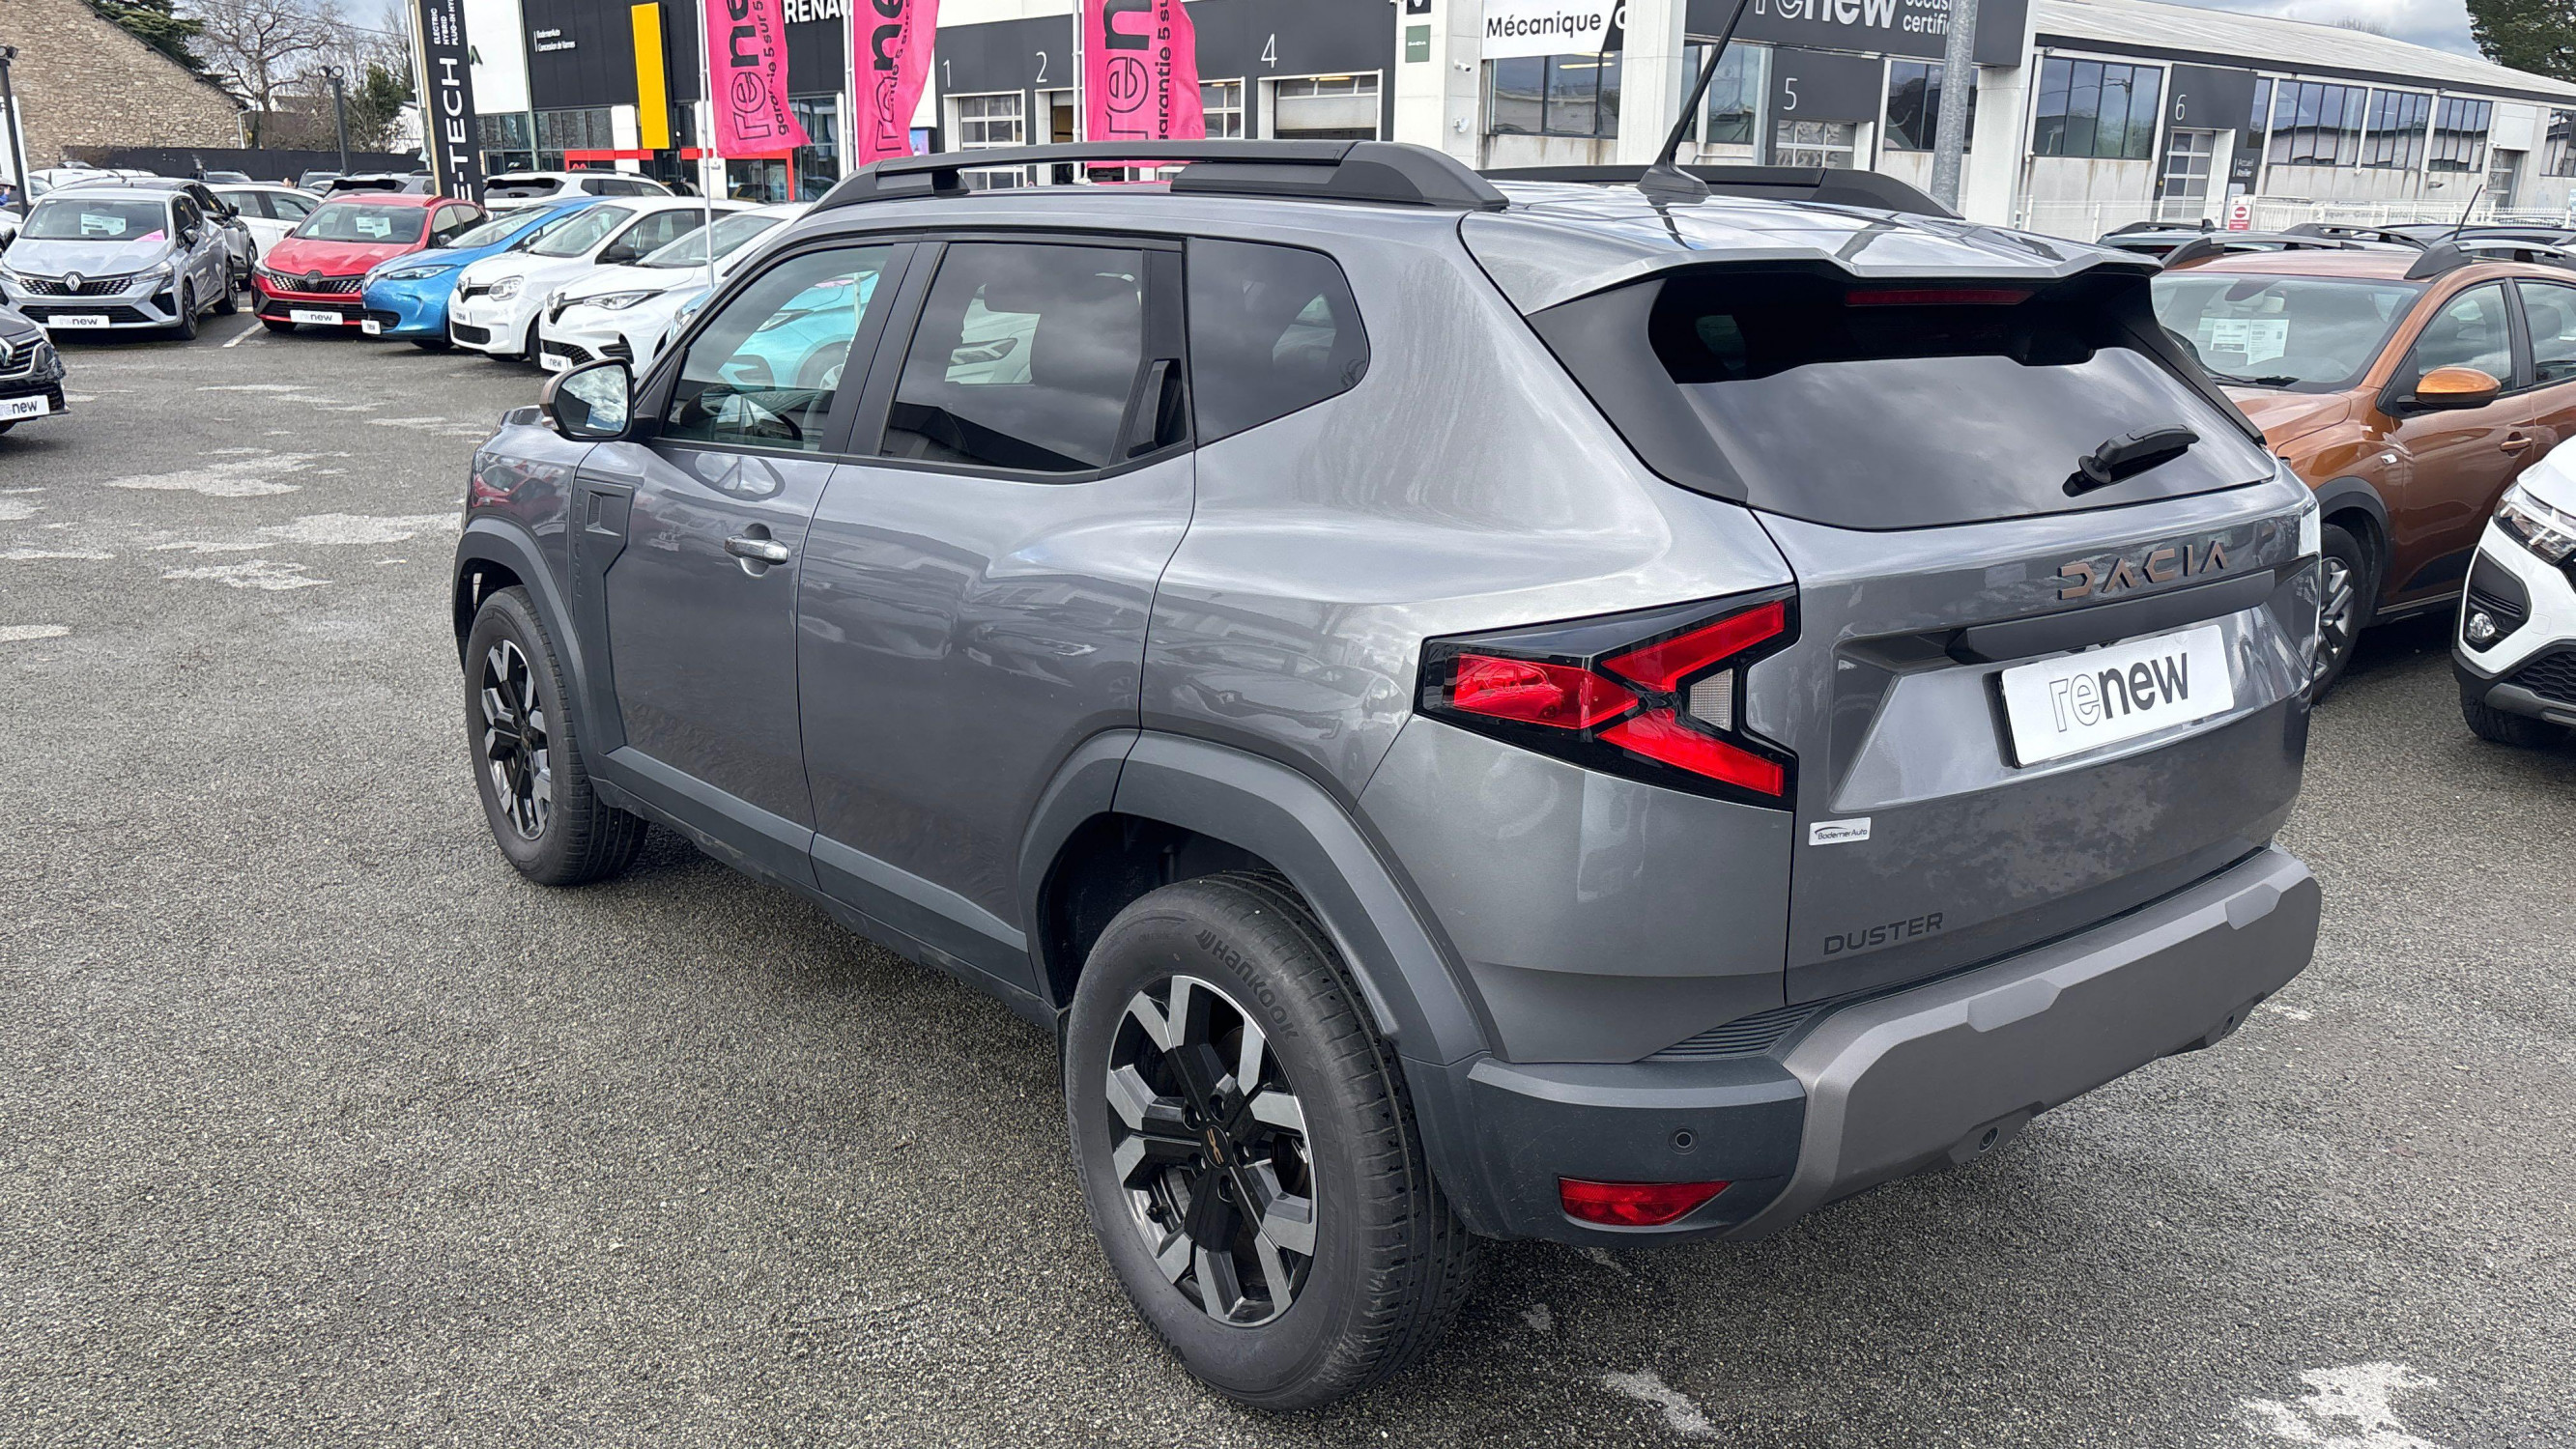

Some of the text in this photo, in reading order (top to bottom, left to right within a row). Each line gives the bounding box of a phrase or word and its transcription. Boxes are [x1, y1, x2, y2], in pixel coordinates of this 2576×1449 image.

[446, 0, 456, 13] HY
[430, 7, 442, 45] ELECTRIC
[440, 14, 450, 45] HYBRID
[1158, 26, 1171, 41] 5
[1486, 11, 1602, 39] Mécanique
[1035, 51, 1048, 83] 2
[1260, 33, 1278, 69] 4
[943, 59, 951, 88] 1
[1783, 77, 1798, 111] 5
[2175, 94, 2189, 121] 6
[439, 57, 472, 202] E-TECH
[2056, 540, 2229, 600] DACIA
[2048, 652, 2189, 732] renew
[1822, 912, 1944, 955] DUSTER
[1211, 939, 1300, 1044] Hankook
